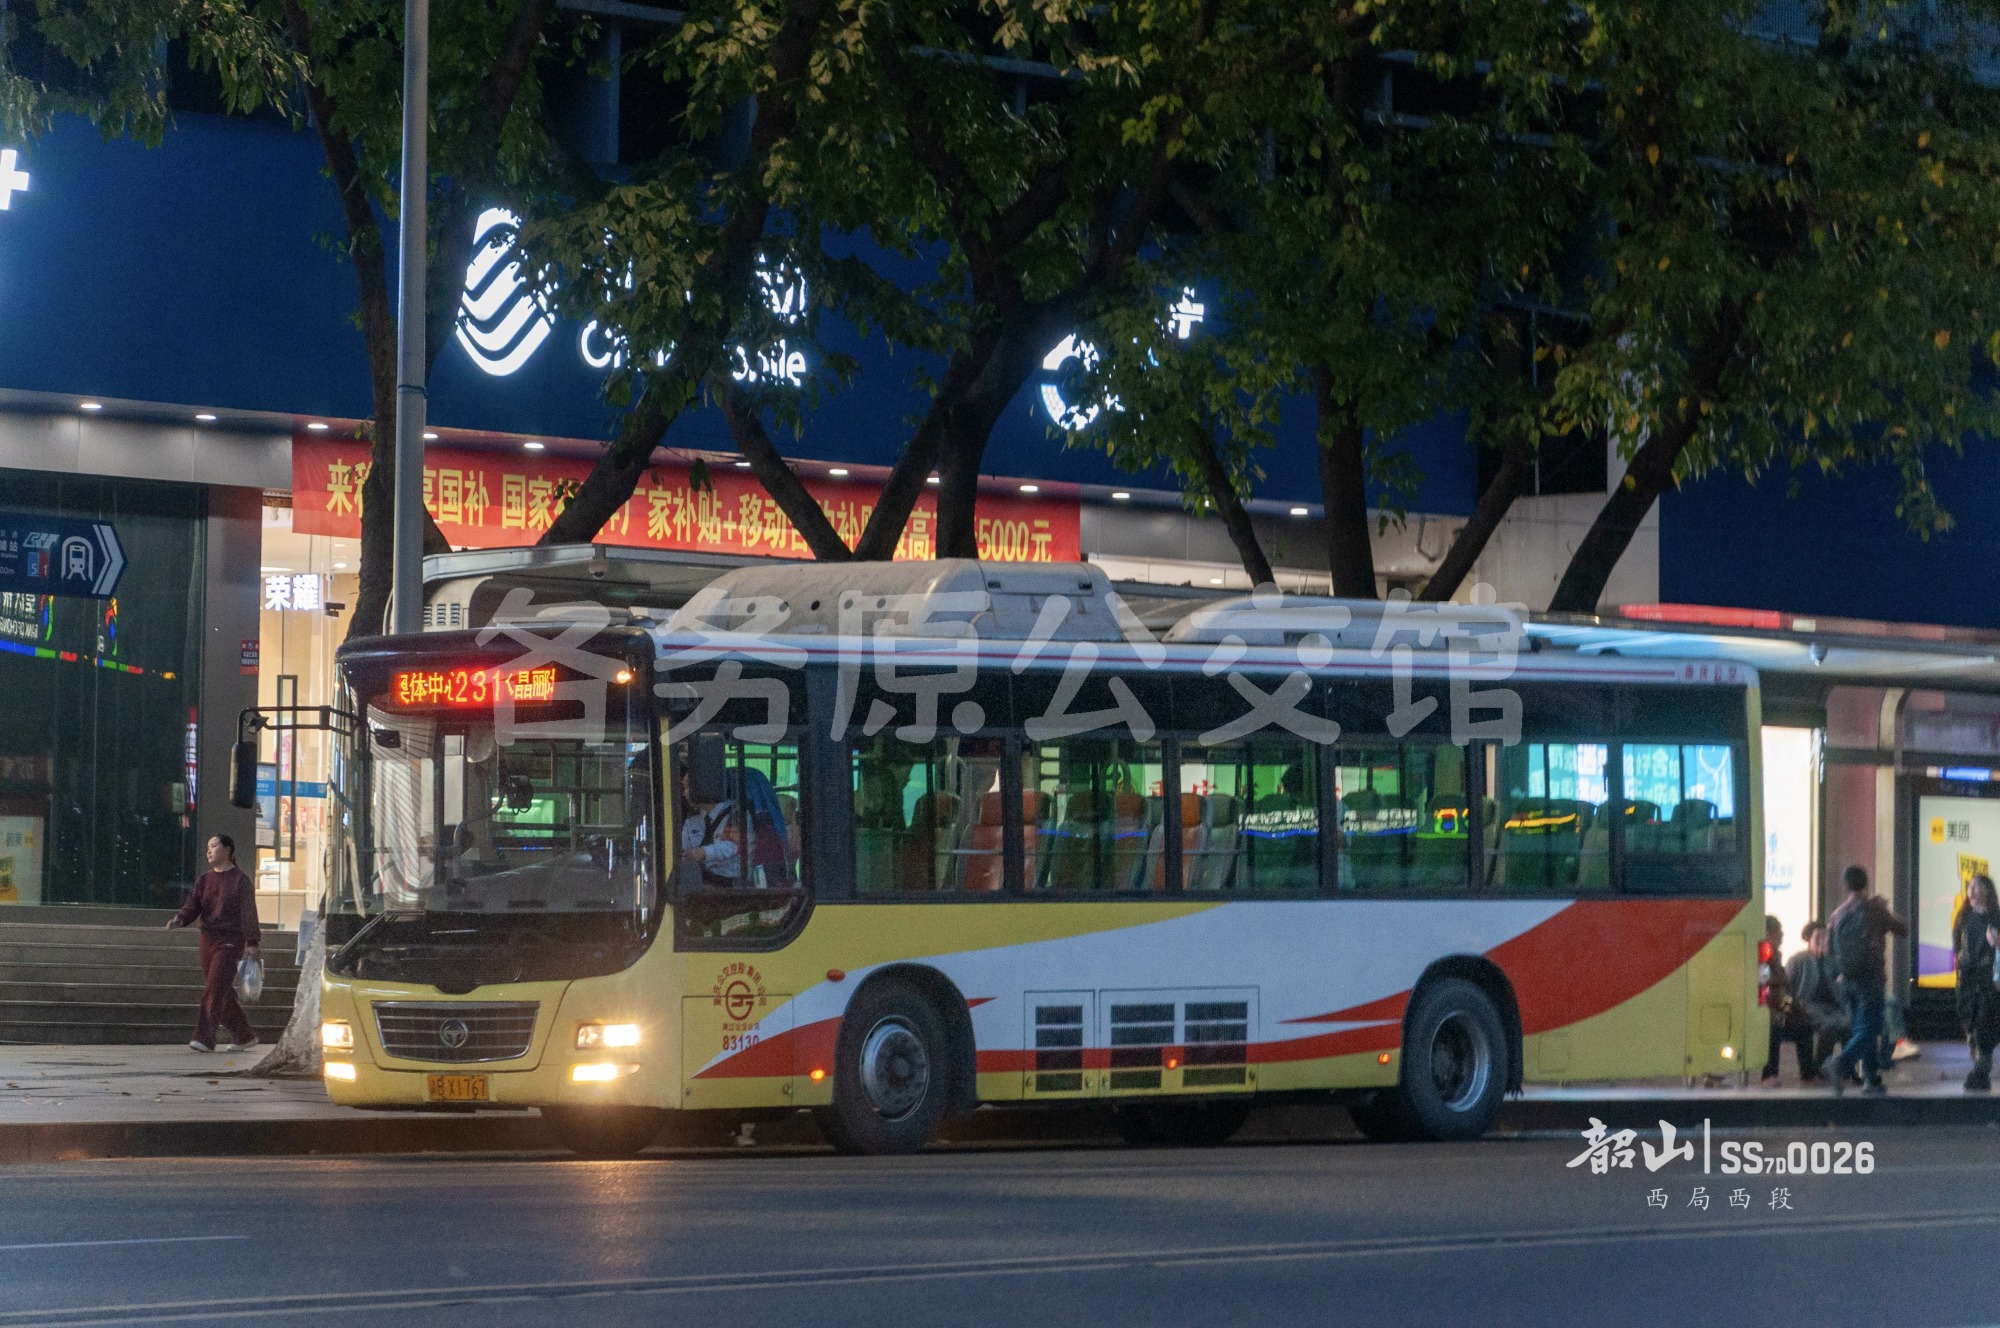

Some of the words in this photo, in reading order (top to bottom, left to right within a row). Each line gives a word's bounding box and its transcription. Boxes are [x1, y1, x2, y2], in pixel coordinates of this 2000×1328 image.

[31, 563, 38, 575] 5
[43, 564, 49, 577] 1
[264, 574, 320, 611] 荣耀
[455, 669, 501, 702] 231
[1947, 820, 1970, 842] 美团
[722, 1034, 760, 1051] 83130
